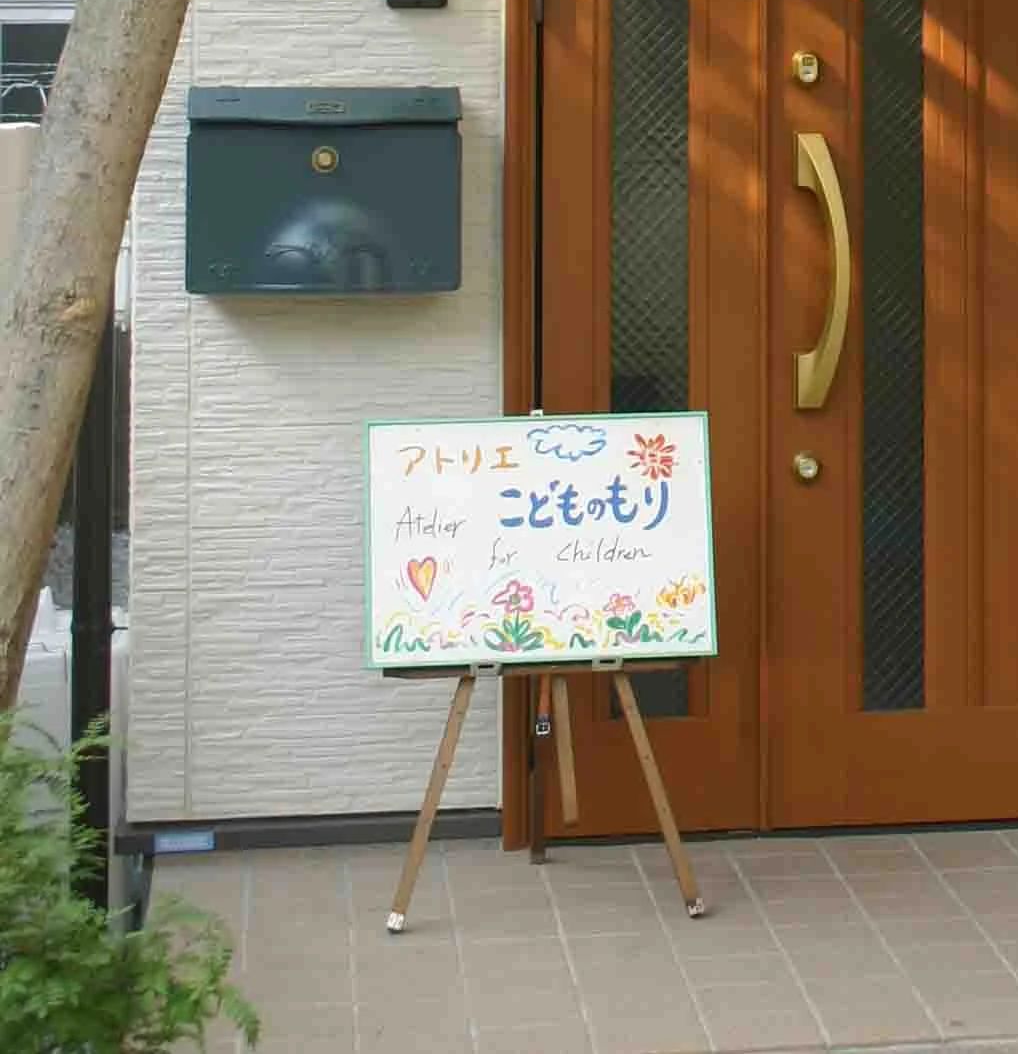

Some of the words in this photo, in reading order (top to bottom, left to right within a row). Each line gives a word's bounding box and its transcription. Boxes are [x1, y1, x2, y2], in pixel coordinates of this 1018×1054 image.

[398, 446, 520, 476] アトリエ
[499, 475, 671, 530] こどものもり
[395, 506, 466, 542] Atelier
[490, 537, 518, 570] for
